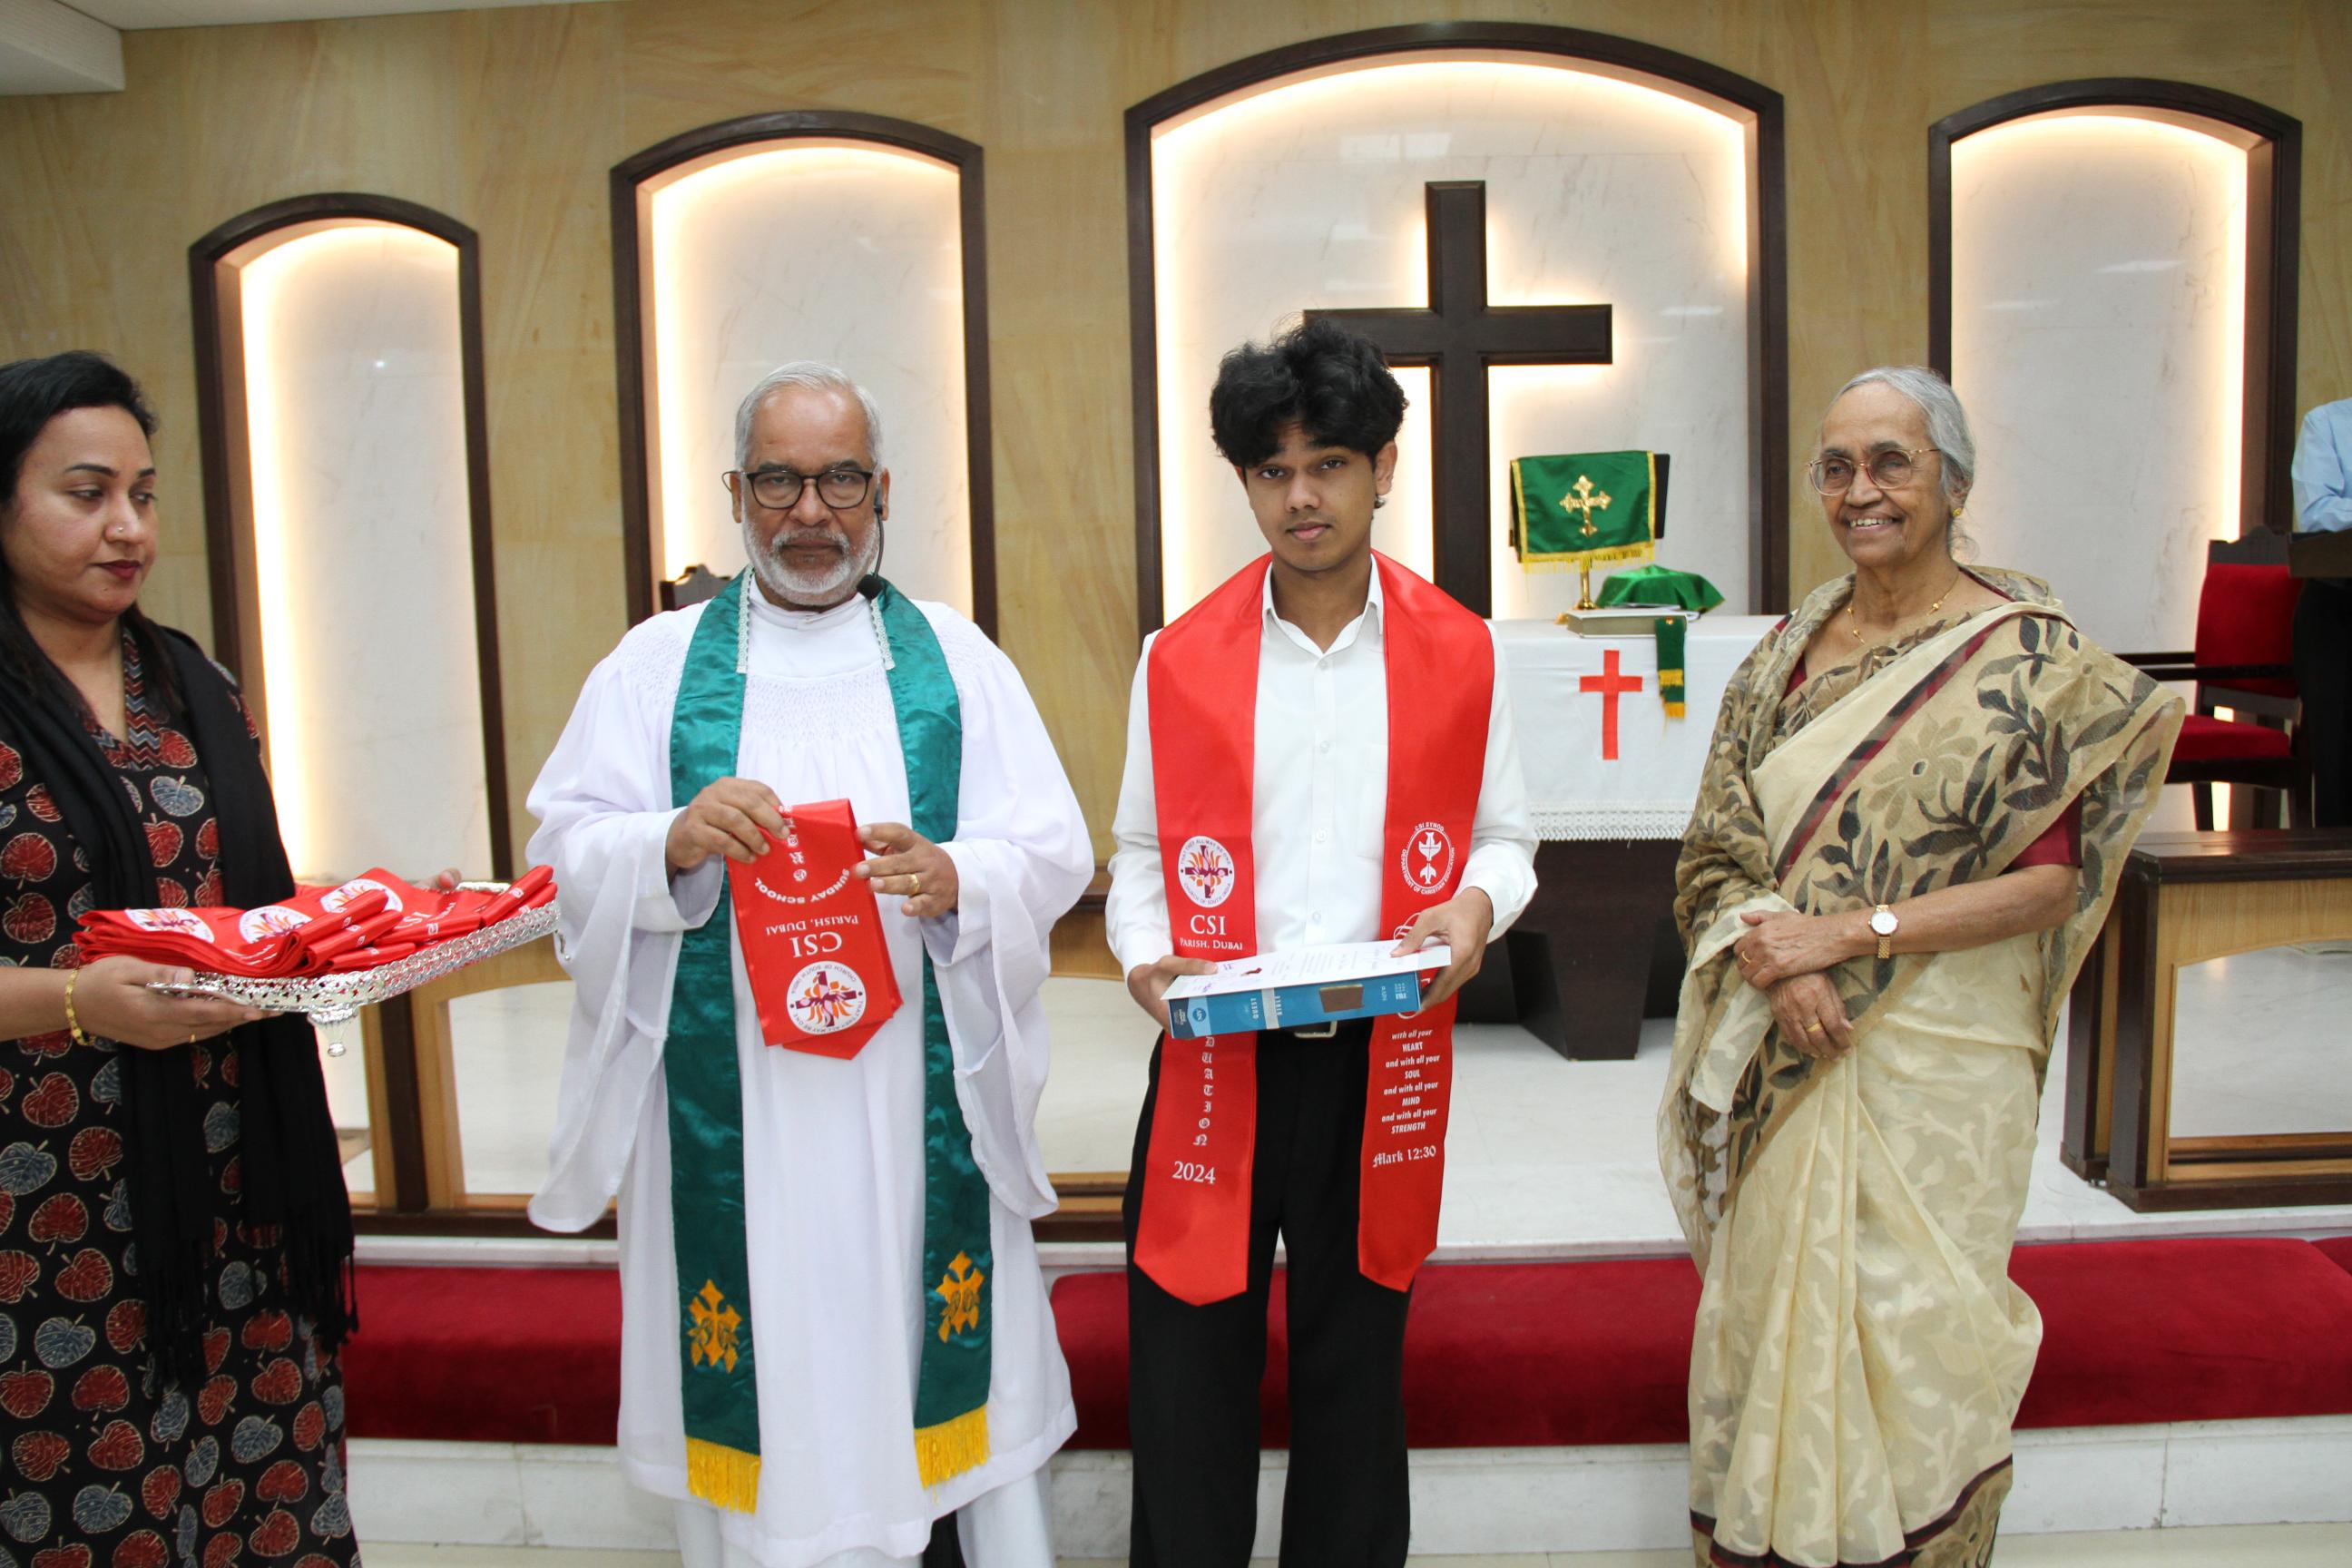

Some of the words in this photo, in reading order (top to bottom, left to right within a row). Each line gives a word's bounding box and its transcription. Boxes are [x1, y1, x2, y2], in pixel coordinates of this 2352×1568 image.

[754, 877, 806, 905] SCHOOL
[810, 868, 850, 903] SUNDAY
[766, 920, 807, 936] DUBAI
[1190, 914, 1227, 936] CSI
[789, 931, 842, 958] CSI
[1212, 939, 1243, 950] DUBAI
[1391, 1031, 1406, 1040] with
[1407, 1029, 1417, 1038] all
[1417, 1029, 1433, 1039] your
[1402, 1041, 1423, 1053] HEART
[1385, 1057, 1398, 1068] and
[1399, 1056, 1416, 1066] with
[1416, 1054, 1425, 1064] all
[1426, 1054, 1440, 1065] your
[1404, 1069, 1420, 1080] SOUL
[1383, 1085, 1397, 1095] and
[1398, 1083, 1413, 1093] with
[1414, 1082, 1423, 1092] all
[1424, 1082, 1438, 1092] your
[1402, 1096, 1420, 1107] MIND
[1381, 1112, 1395, 1122] and
[1396, 1110, 1411, 1121] with
[1413, 1108, 1421, 1118] all
[1422, 1108, 1437, 1119] your
[1391, 1121, 1426, 1134] STRENGTH
[1372, 1150, 1403, 1168] Mark
[1407, 1144, 1436, 1161] 12:30
[1171, 1161, 1217, 1185] 2024
